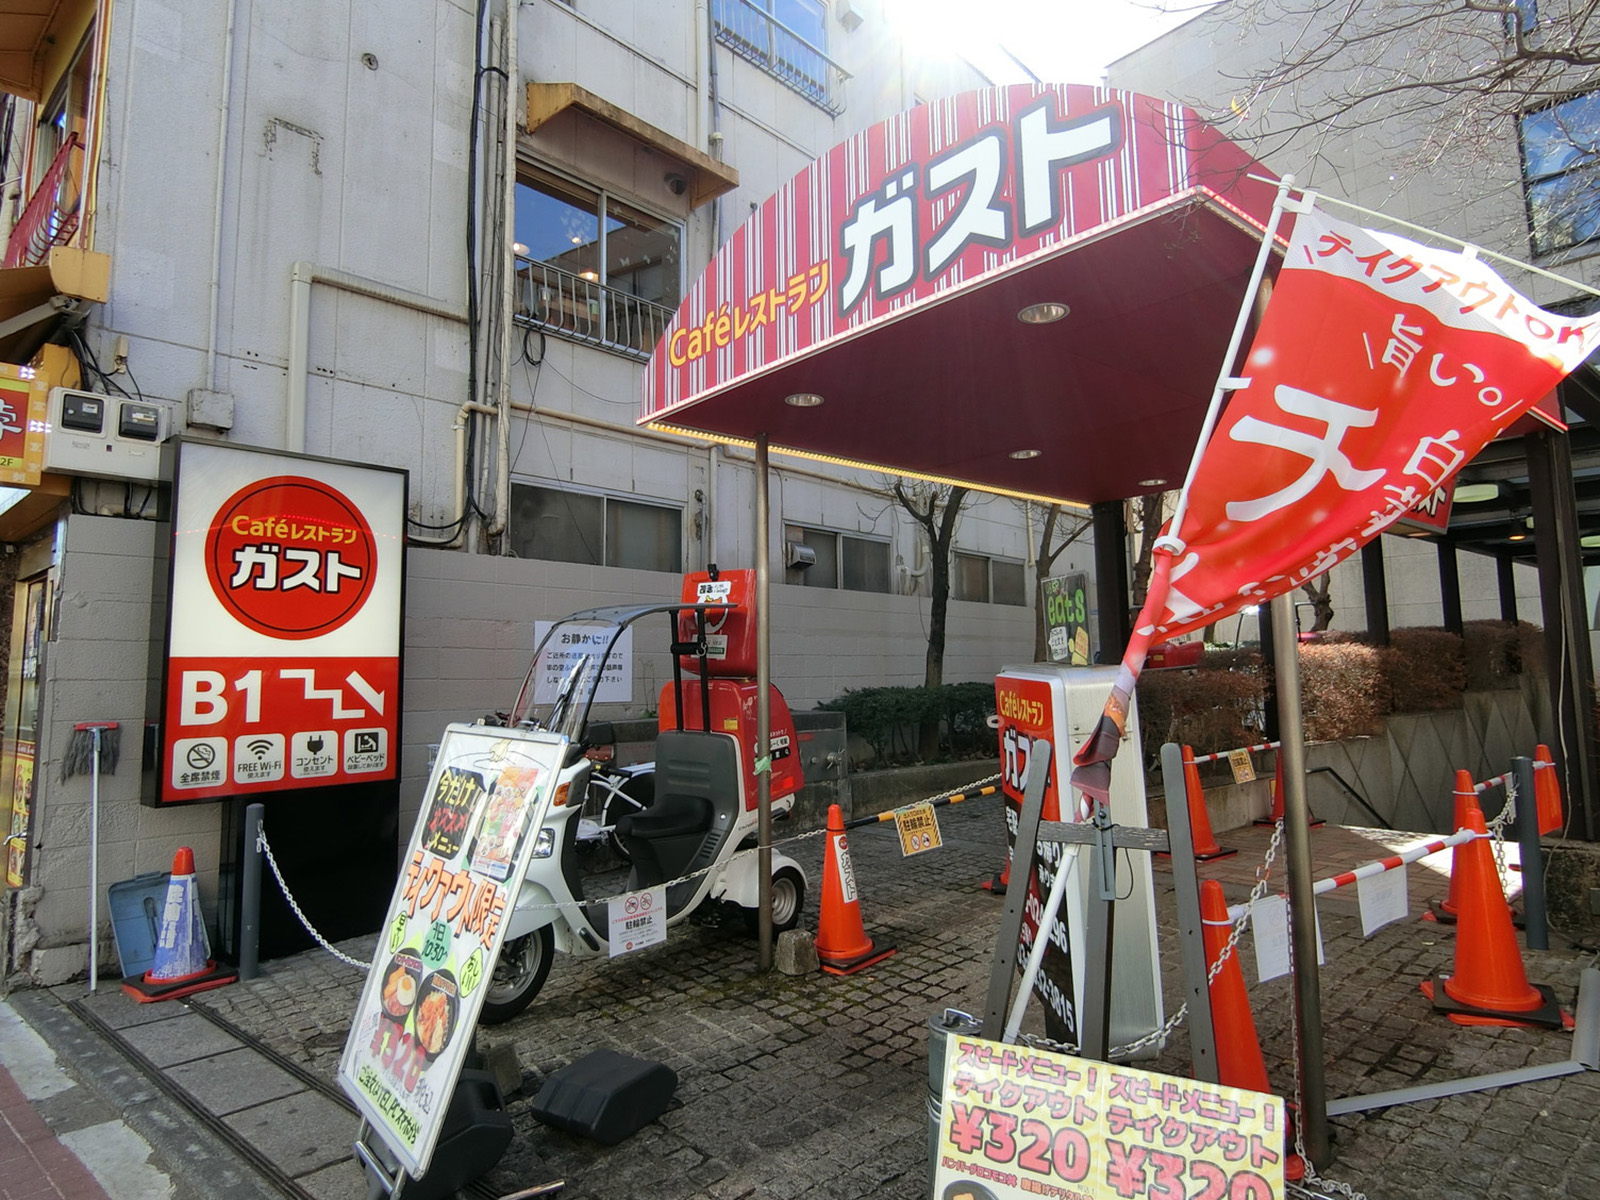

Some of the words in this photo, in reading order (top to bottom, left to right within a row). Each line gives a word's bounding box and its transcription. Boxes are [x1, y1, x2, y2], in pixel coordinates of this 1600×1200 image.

[839, 102, 1115, 313] ガスト
[669, 261, 829, 367] Caféレストラン
[231, 514, 358, 544] Caféレストラン
[231, 544, 362, 593] ガスト
[1048, 588, 1085, 626] eats
[180, 670, 262, 726] B1
[999, 690, 1044, 727] Caféレストラン
[180, 770, 221, 784] 全席禁煙
[238, 763, 258, 772] FREE
[260, 761, 282, 771] Wi-Fi
[296, 756, 334, 767] コンセント
[437, 768, 477, 807] 今だけ
[429, 831, 460, 854] メニュー
[402, 850, 506, 951] テイクアウト限定
[369, 1012, 427, 1094] ¥320
[953, 1071, 1098, 1126] テイクアウト
[949, 1101, 1091, 1184] ¥320
[1106, 1105, 1279, 1169] テイクアウト
[1105, 1138, 1274, 1200] ¥320
